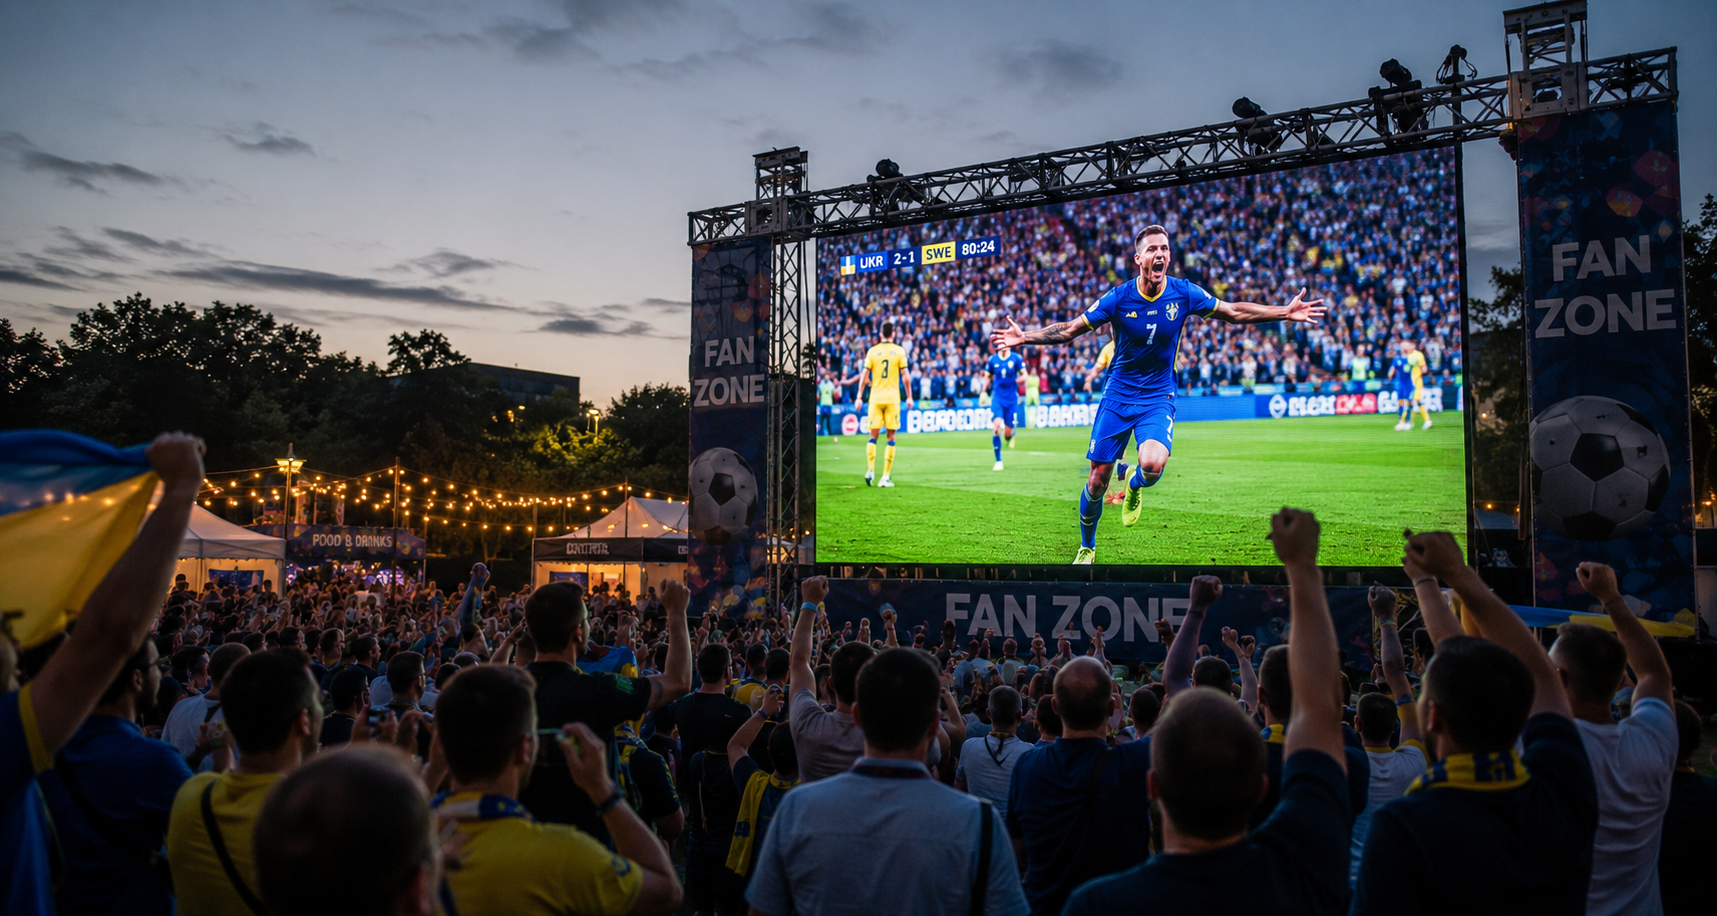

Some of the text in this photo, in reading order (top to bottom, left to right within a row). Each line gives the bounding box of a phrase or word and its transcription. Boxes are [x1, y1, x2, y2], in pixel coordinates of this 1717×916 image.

[860, 240, 995, 269] UKR 2-1 SWE 80:24
[1552, 235, 1652, 282] FAN
[1534, 288, 1677, 339] ZONE
[1146, 323, 1158, 345] 7
[704, 336, 755, 368] FAN
[693, 374, 765, 407] ZONE
[945, 593, 1036, 639] FAN
